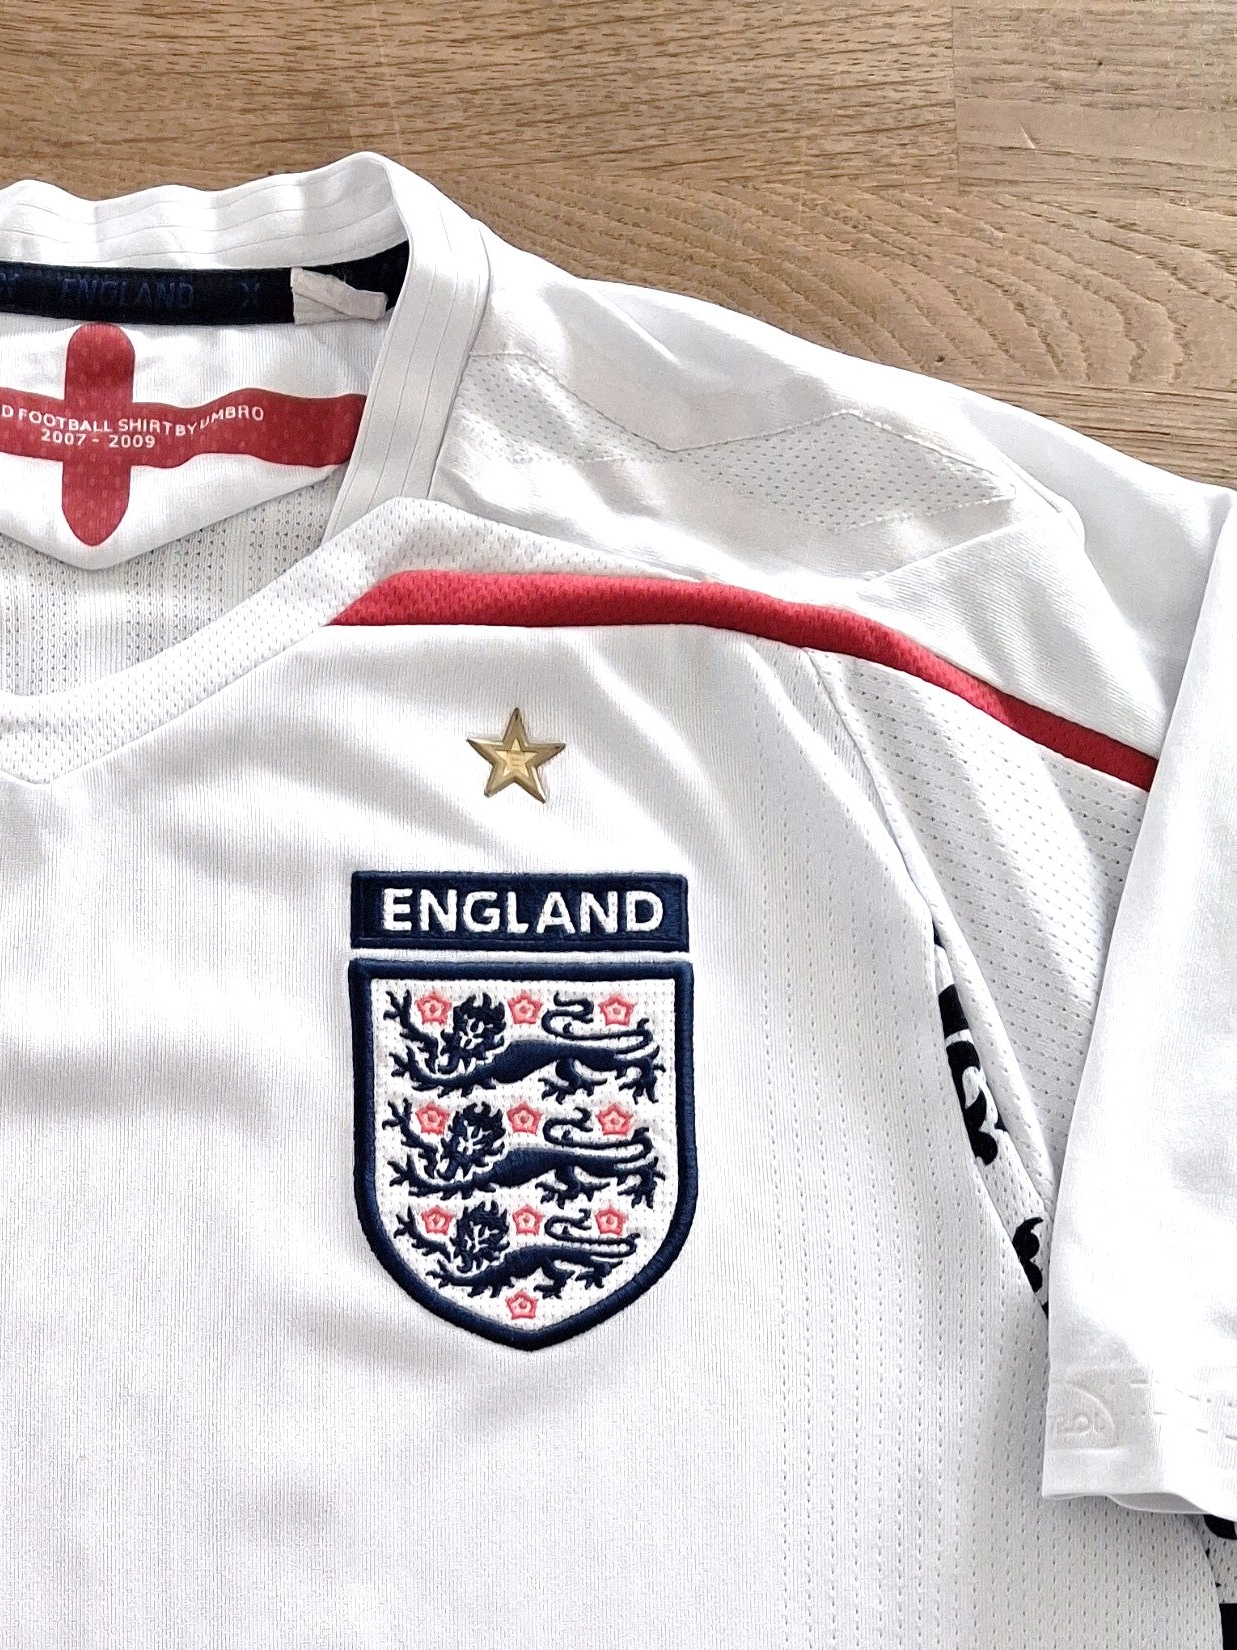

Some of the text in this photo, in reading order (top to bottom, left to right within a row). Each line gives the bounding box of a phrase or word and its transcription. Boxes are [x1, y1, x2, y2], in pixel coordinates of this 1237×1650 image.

[18, 407, 113, 433] FOOTBALL
[117, 418, 173, 436] SHIRT
[175, 422, 198, 437] BY
[199, 405, 265, 430] UMBRO
[41, 428, 86, 446] 2007
[108, 434, 156, 448] 2009
[382, 887, 664, 934] ENGLAND
